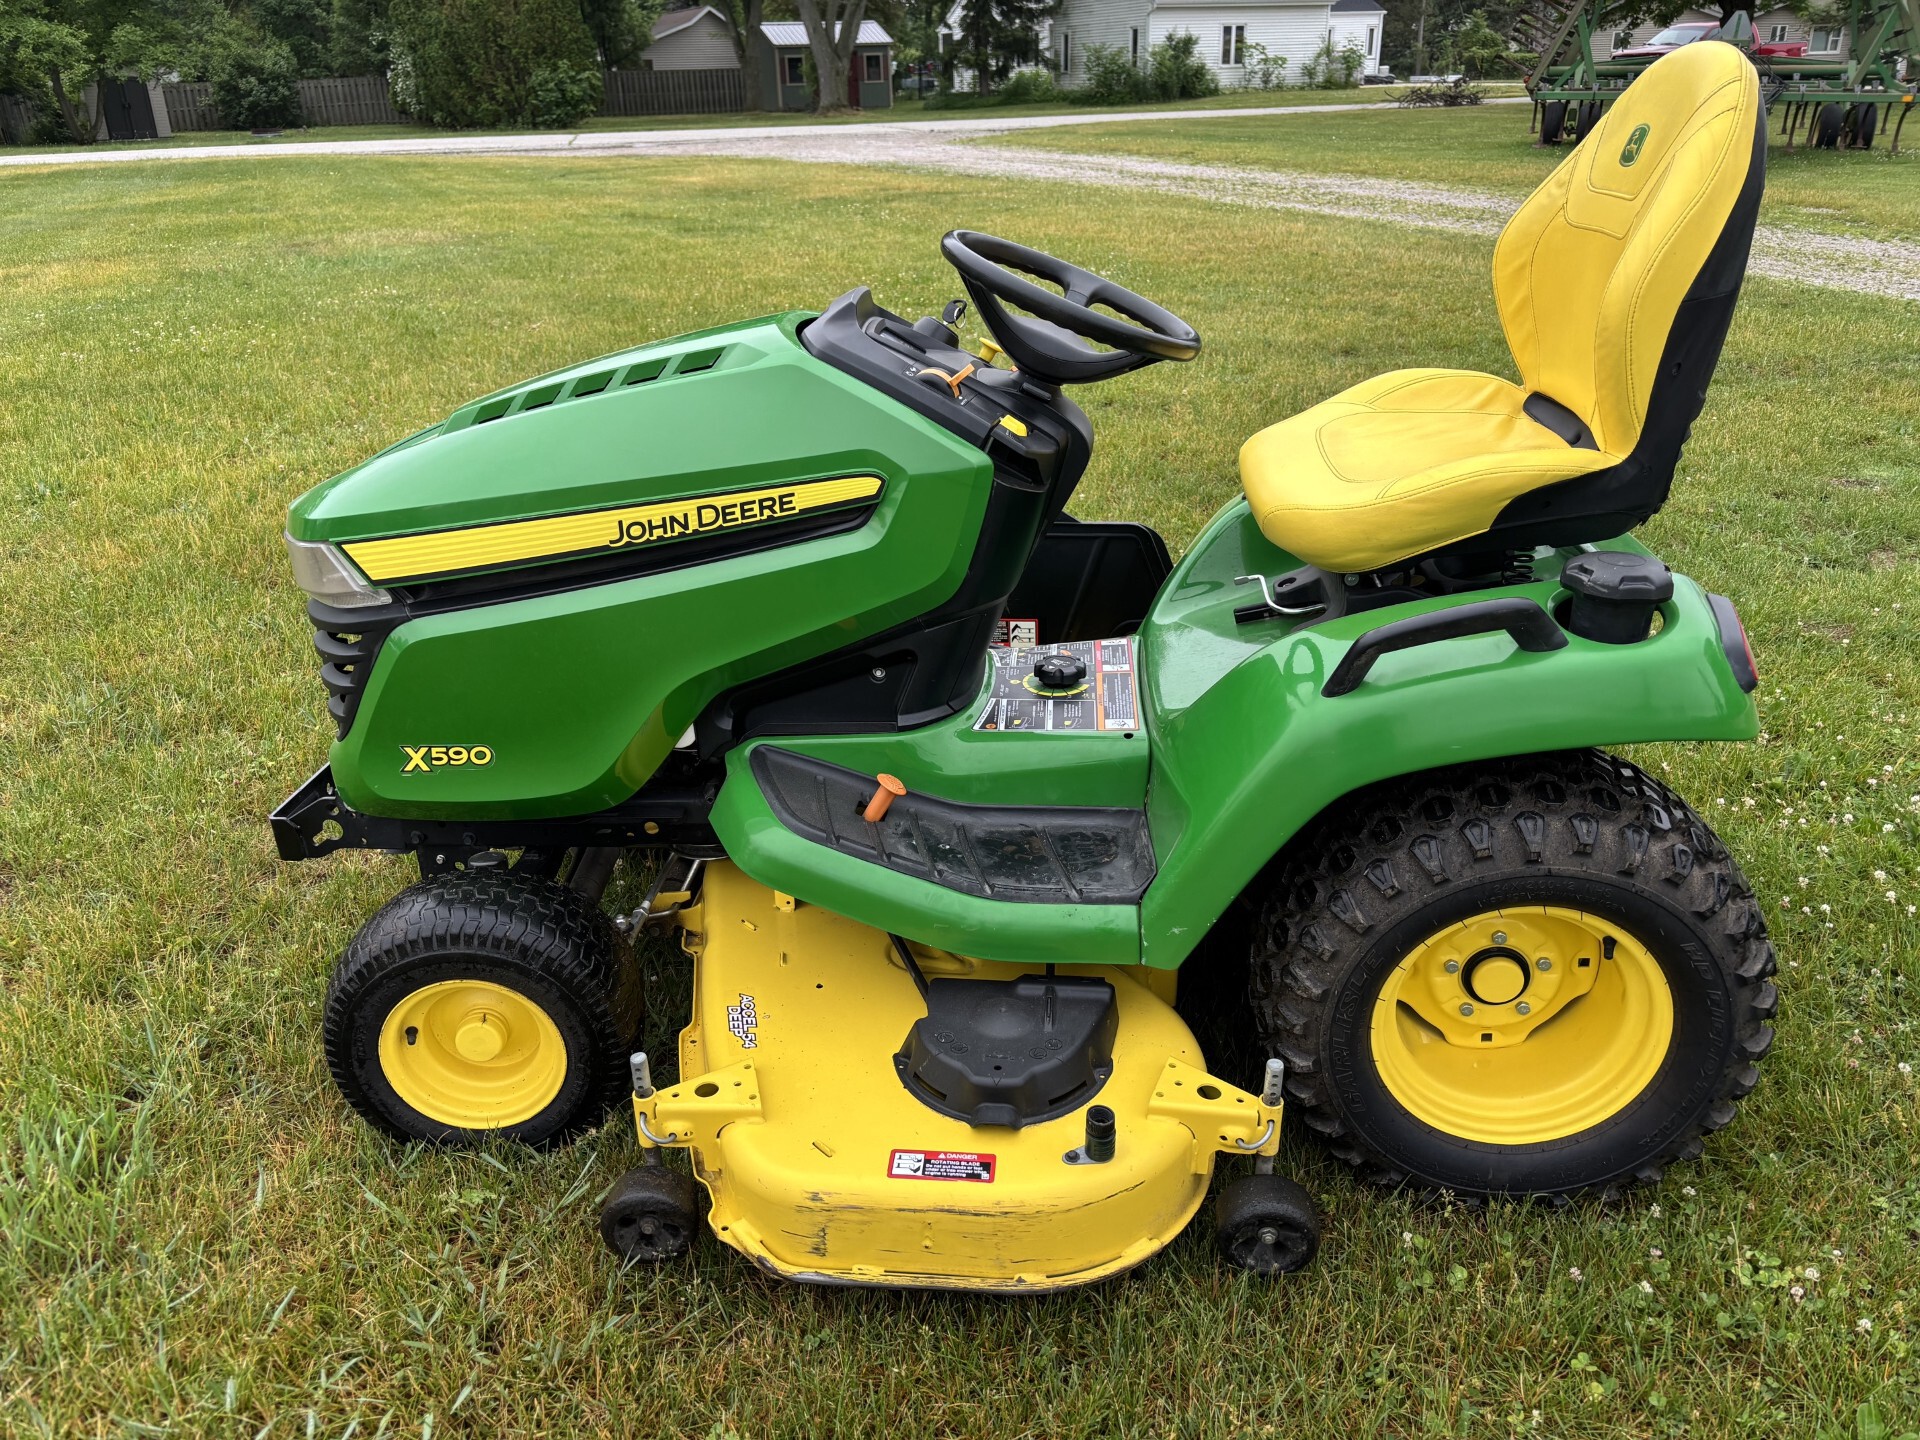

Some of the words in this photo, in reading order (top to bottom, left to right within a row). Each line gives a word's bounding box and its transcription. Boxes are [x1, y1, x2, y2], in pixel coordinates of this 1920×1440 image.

[609, 513, 689, 545] JOHN
[697, 492, 796, 528] DEERE
[401, 745, 492, 772] X590
[727, 1006, 743, 1037] DEEP
[739, 993, 757, 1032] ACCEL
[742, 1033, 757, 1049] 54
